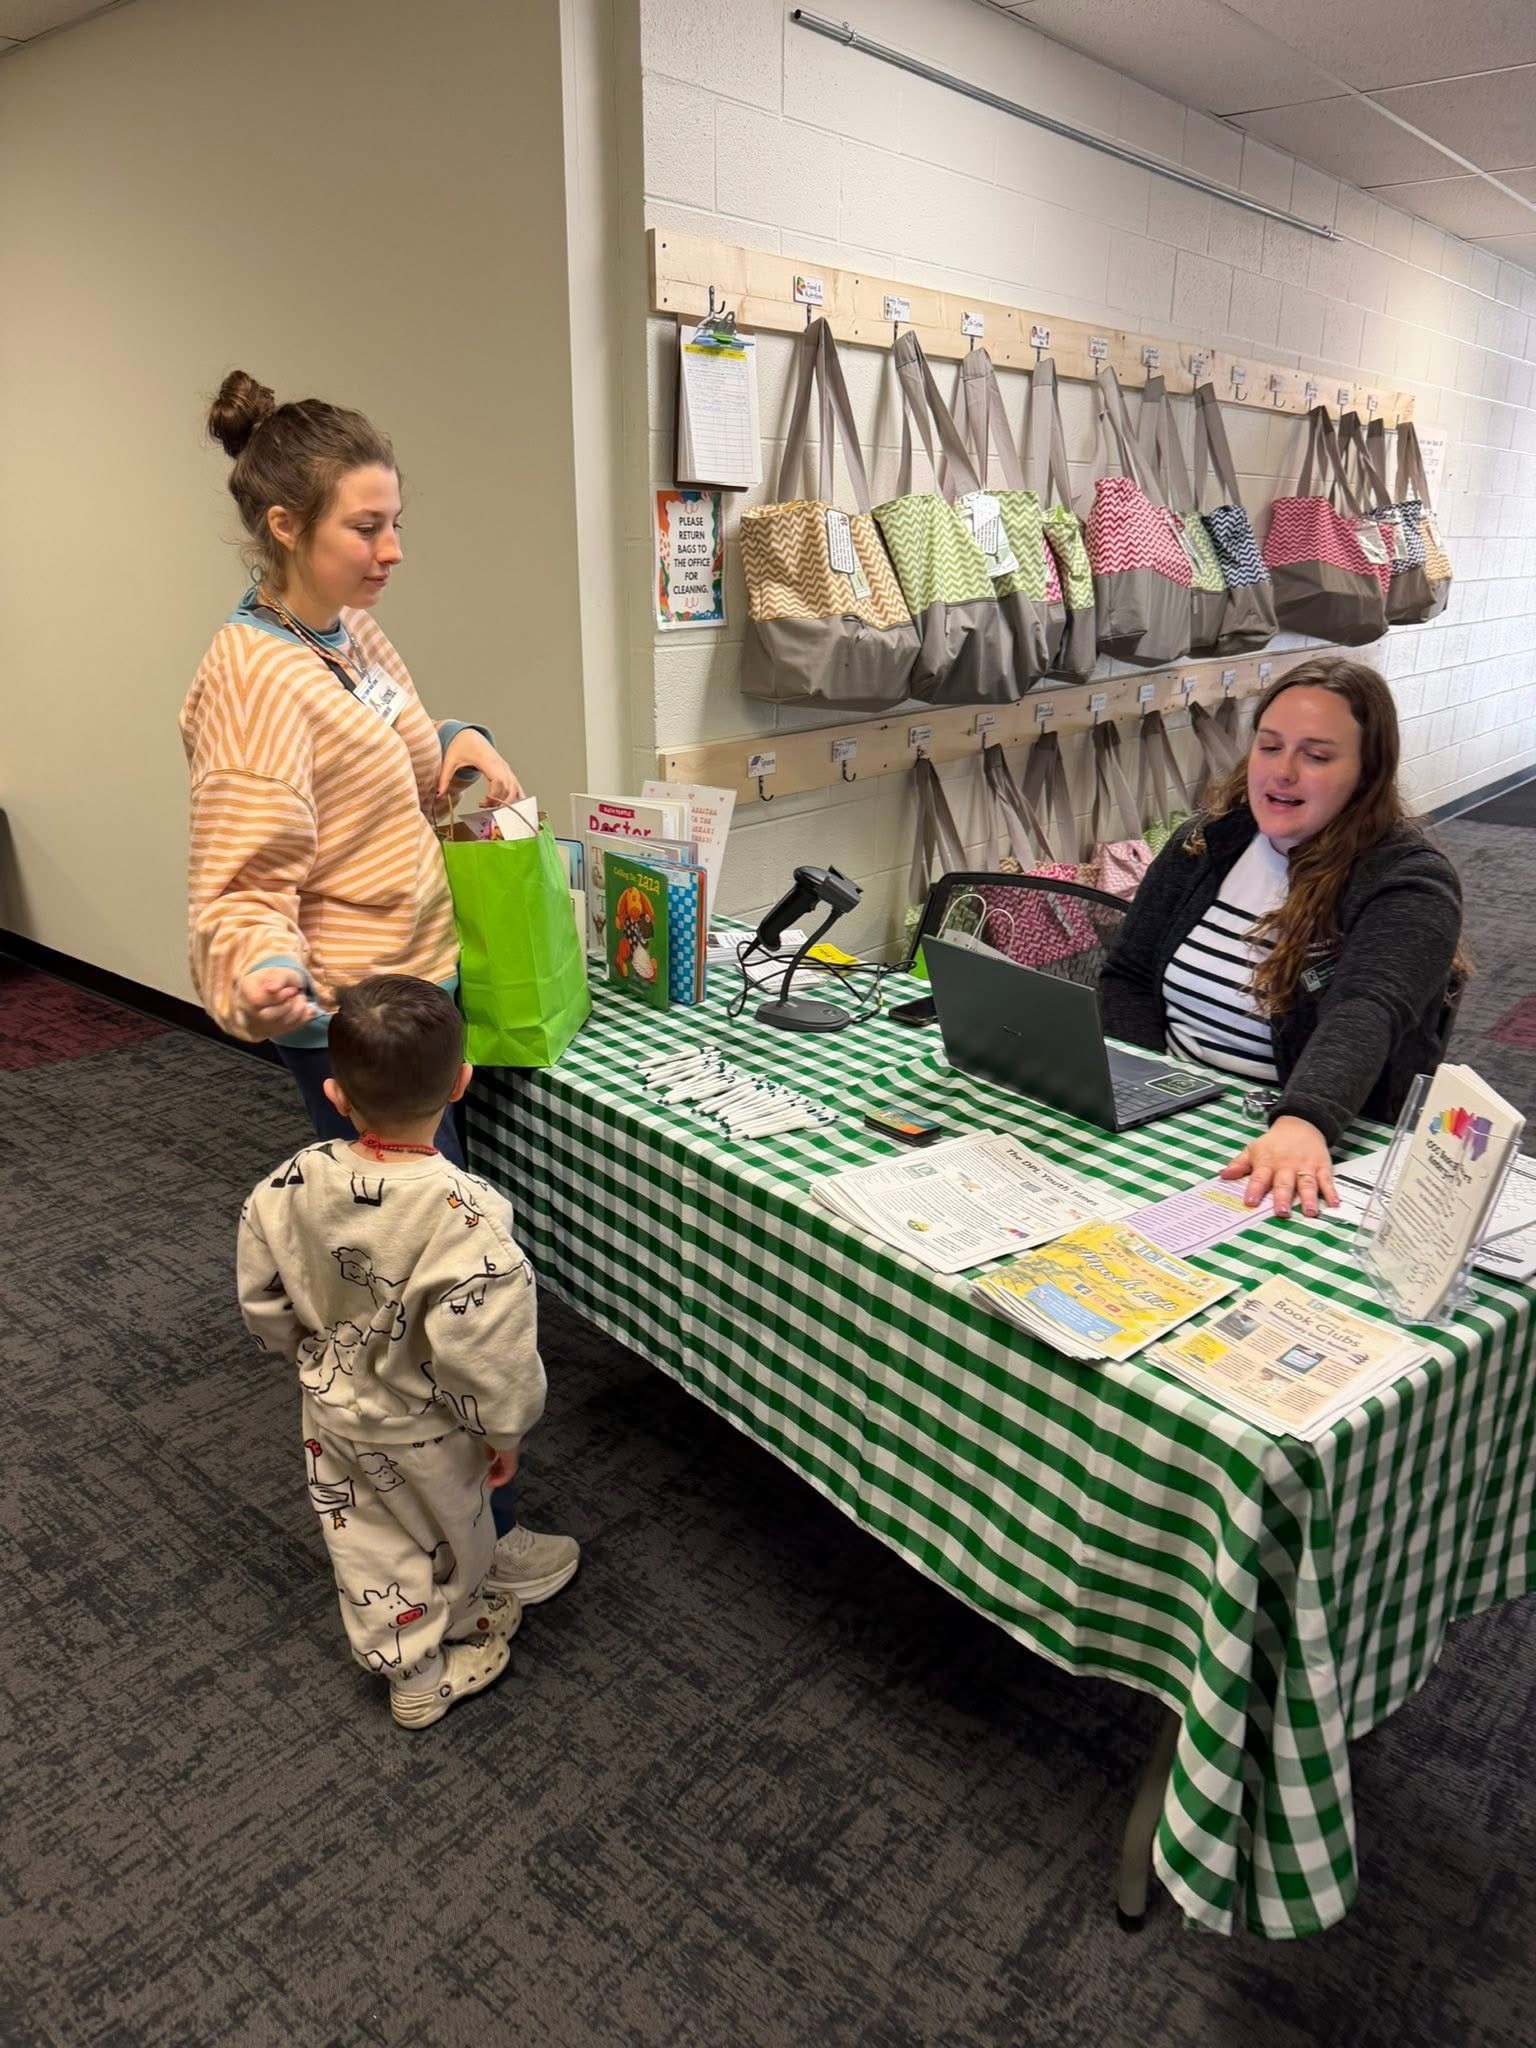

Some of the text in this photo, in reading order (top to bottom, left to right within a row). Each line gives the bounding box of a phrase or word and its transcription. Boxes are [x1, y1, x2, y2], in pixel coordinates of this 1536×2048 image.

[679, 517, 704, 526] PLEASE
[679, 531, 705, 540] RETURN
[677, 545, 708, 554] BAGS TO
[674, 558, 710, 567] THE OFFICE
[684, 571, 698, 580] FOR
[673, 585, 709, 595] CLEANING.
[1006, 1148, 1099, 1206] The DPL Youth Times
[1079, 1250, 1148, 1291] March
[1103, 1242, 1139, 1267] ADULT
[1140, 1268, 1204, 1300] PROGRAMS
[1273, 1300, 1314, 1325] Book
[1316, 1324, 1361, 1348] Clubs
